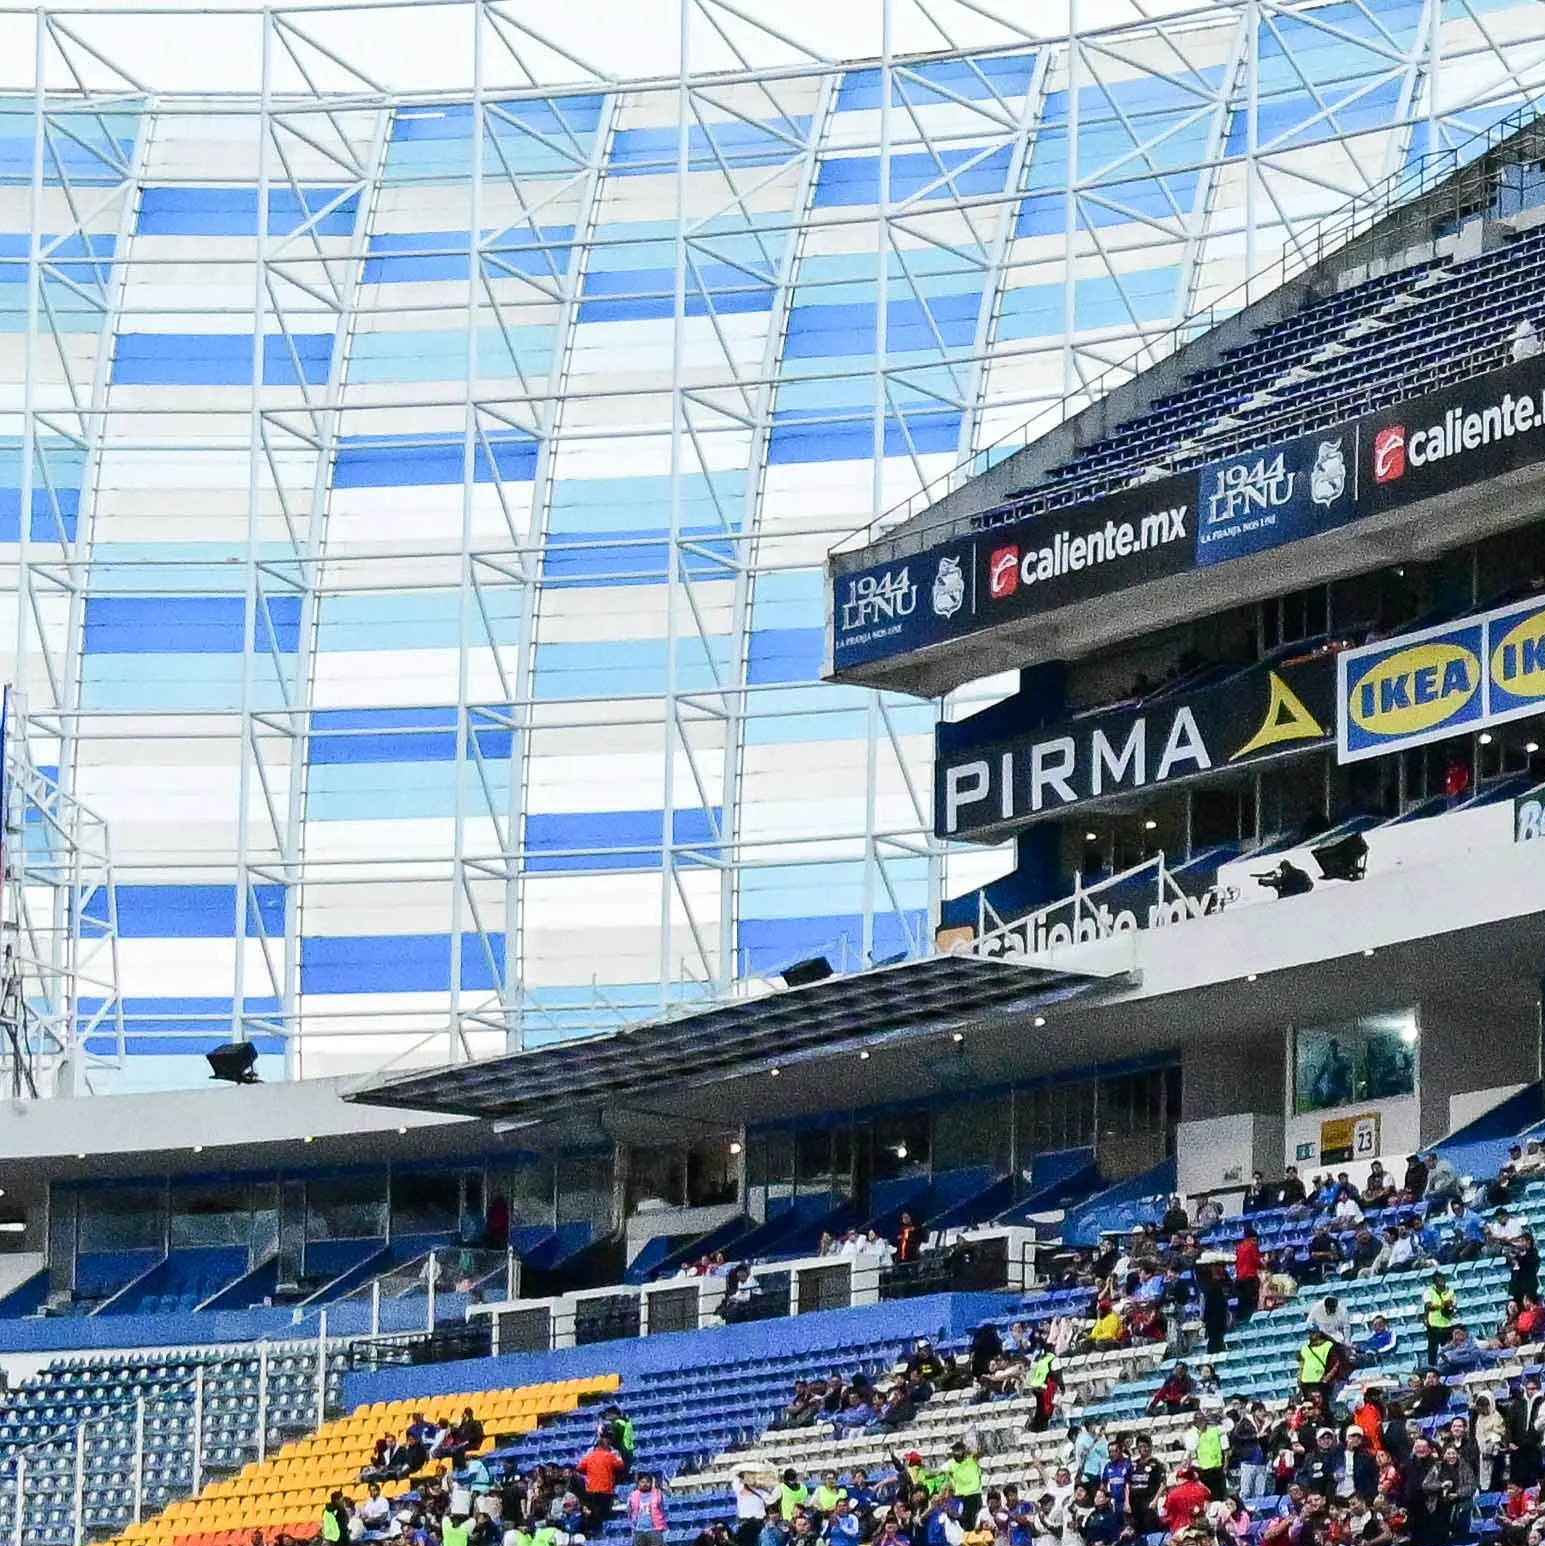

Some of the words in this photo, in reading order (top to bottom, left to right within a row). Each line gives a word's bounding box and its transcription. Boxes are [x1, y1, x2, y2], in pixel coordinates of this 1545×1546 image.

[1207, 471, 1296, 525] LFNU
[1216, 451, 1286, 497] 1944
[1021, 504, 1188, 585] caliente.mx
[842, 584, 918, 632] LFNU
[849, 566, 911, 606] 1944
[1360, 657, 1472, 720] IKEA
[946, 706, 1211, 832] PIRMA
[1358, 1131, 1372, 1152] 23
